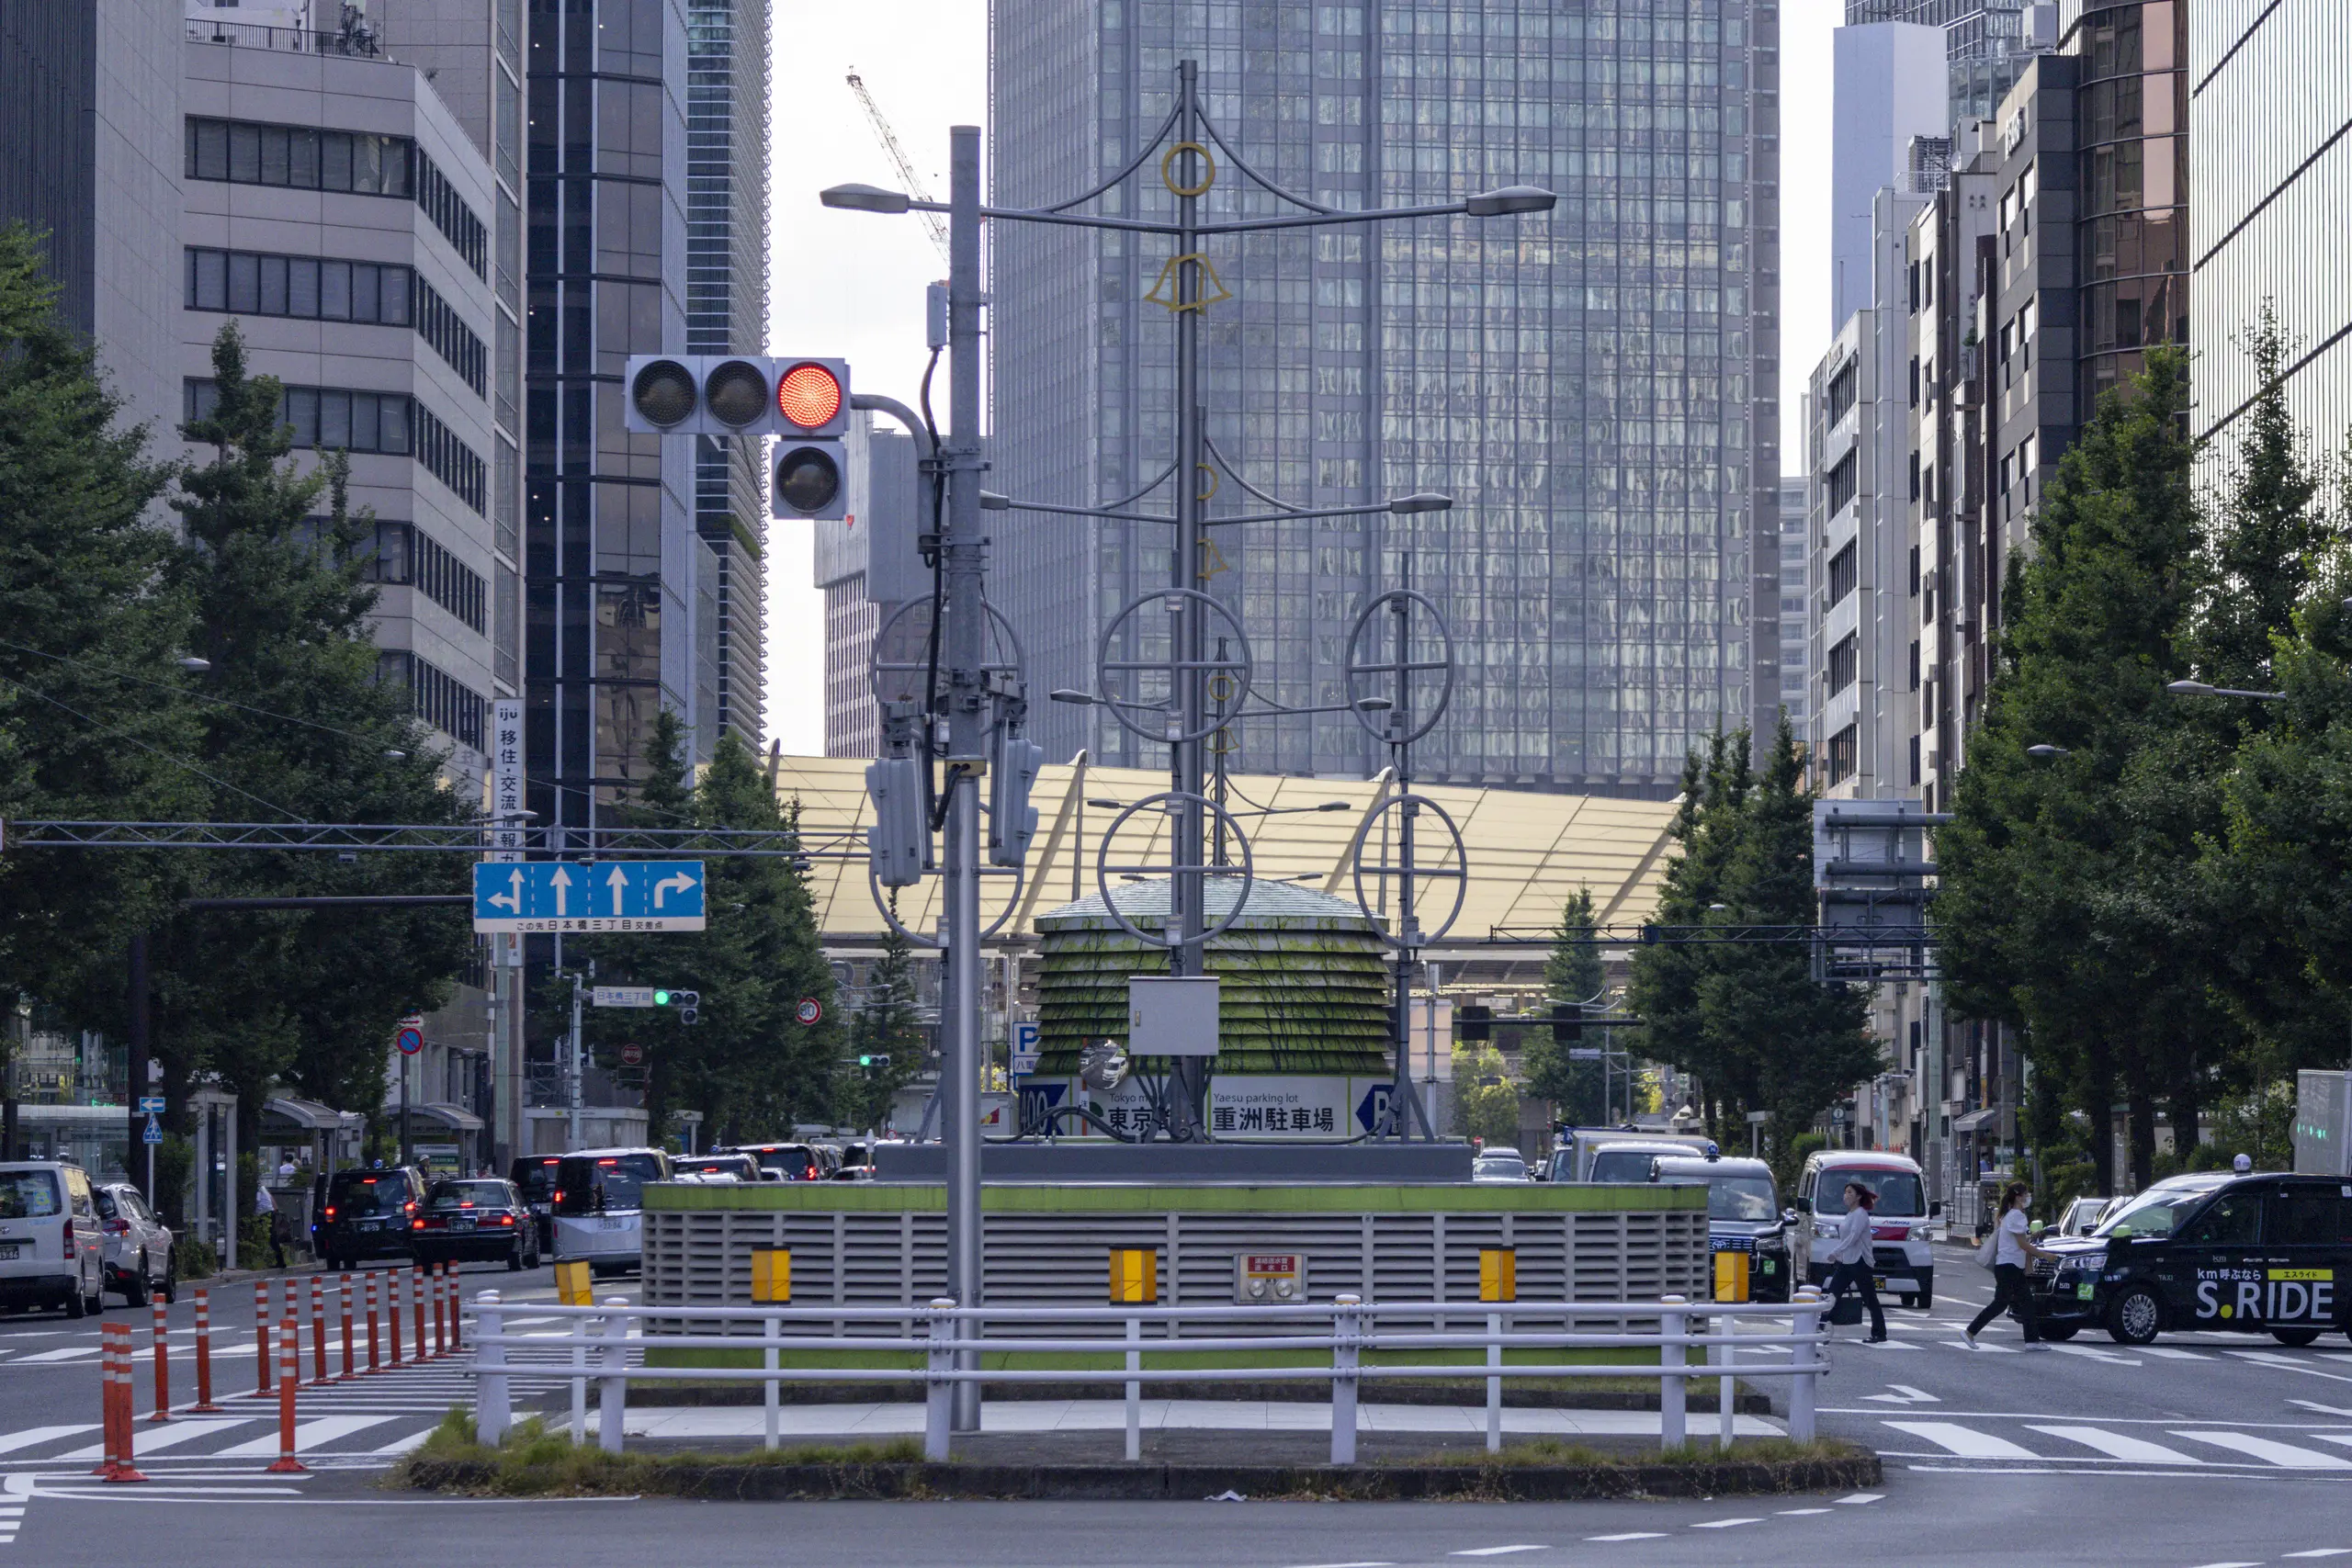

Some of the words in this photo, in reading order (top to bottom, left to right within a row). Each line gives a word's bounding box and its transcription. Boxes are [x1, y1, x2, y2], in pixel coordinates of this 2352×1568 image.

[597, 991, 650, 1000] 日本橋三丁目
[1019, 1027, 1039, 1053] P
[1110, 1093, 1136, 1105] Tokyo
[1214, 1093, 1243, 1103] Yaesu
[1246, 1093, 1283, 1106] parking
[1286, 1093, 1298, 1103] lot
[2284, 1270, 2318, 1279] エスライド
[2196, 1280, 2334, 1319] S.RIDE
